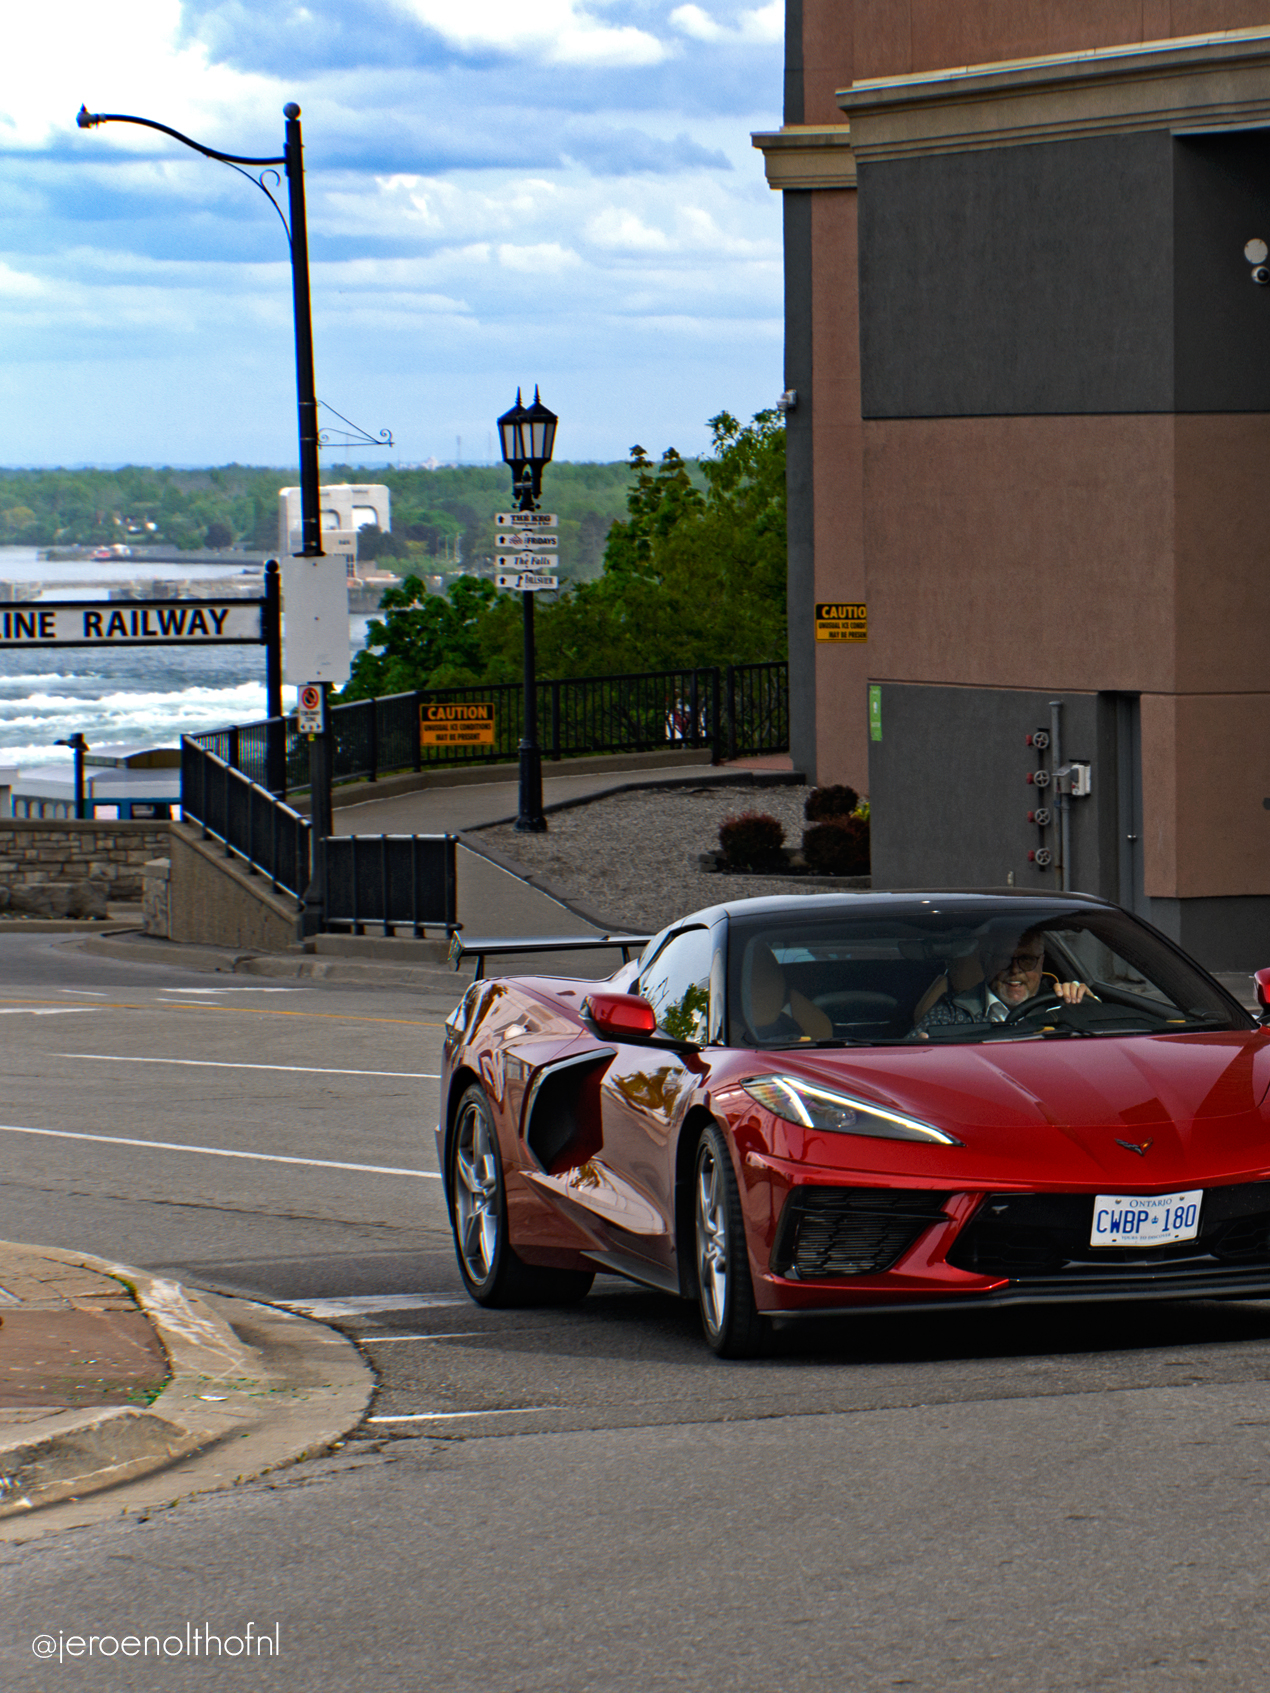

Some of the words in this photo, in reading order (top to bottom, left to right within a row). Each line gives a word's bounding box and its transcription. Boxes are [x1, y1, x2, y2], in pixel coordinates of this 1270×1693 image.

[514, 557, 529, 565] The
[531, 557, 550, 565] Falls
[821, 605, 867, 618] CAUTIO
[0, 611, 57, 639] INE
[83, 608, 230, 638] RAILWAY
[427, 706, 488, 720] CAUTION
[1129, 1198, 1173, 1208] ONTARIO
[1096, 1209, 1149, 1234] CWBP
[1162, 1204, 1197, 1232] 180
